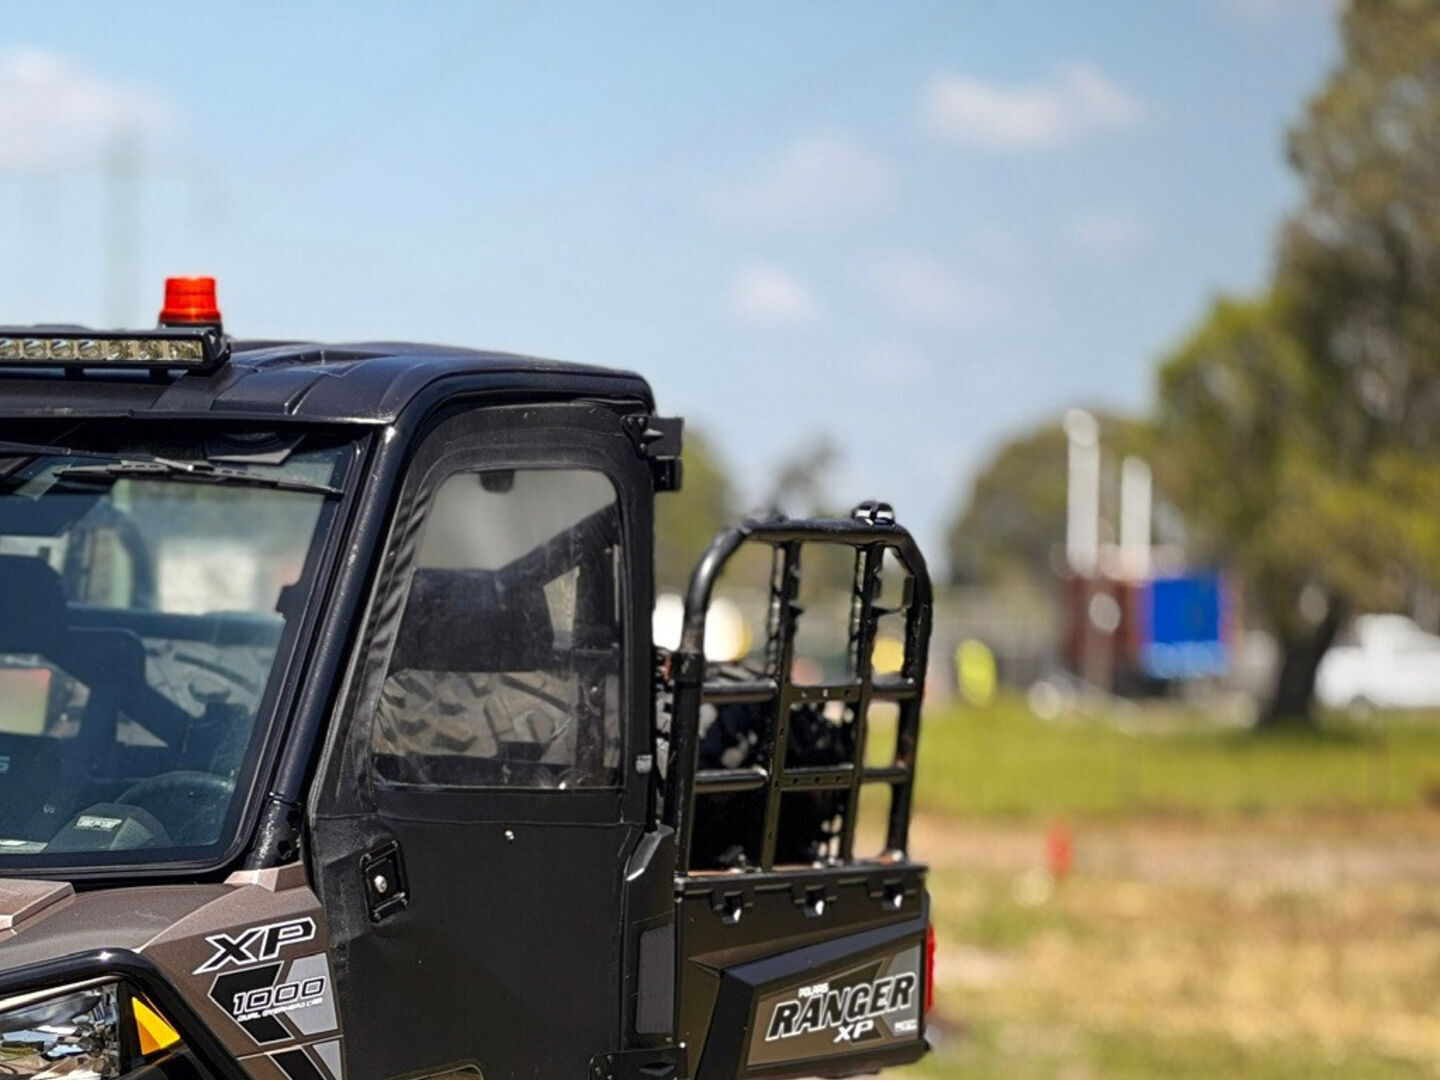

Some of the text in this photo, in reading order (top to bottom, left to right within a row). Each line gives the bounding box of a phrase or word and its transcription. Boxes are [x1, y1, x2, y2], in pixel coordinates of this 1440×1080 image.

[192, 917, 316, 975] XP
[233, 976, 326, 1015] 1000
[765, 972, 917, 1041] RANGER
[832, 1020, 874, 1043] XP
